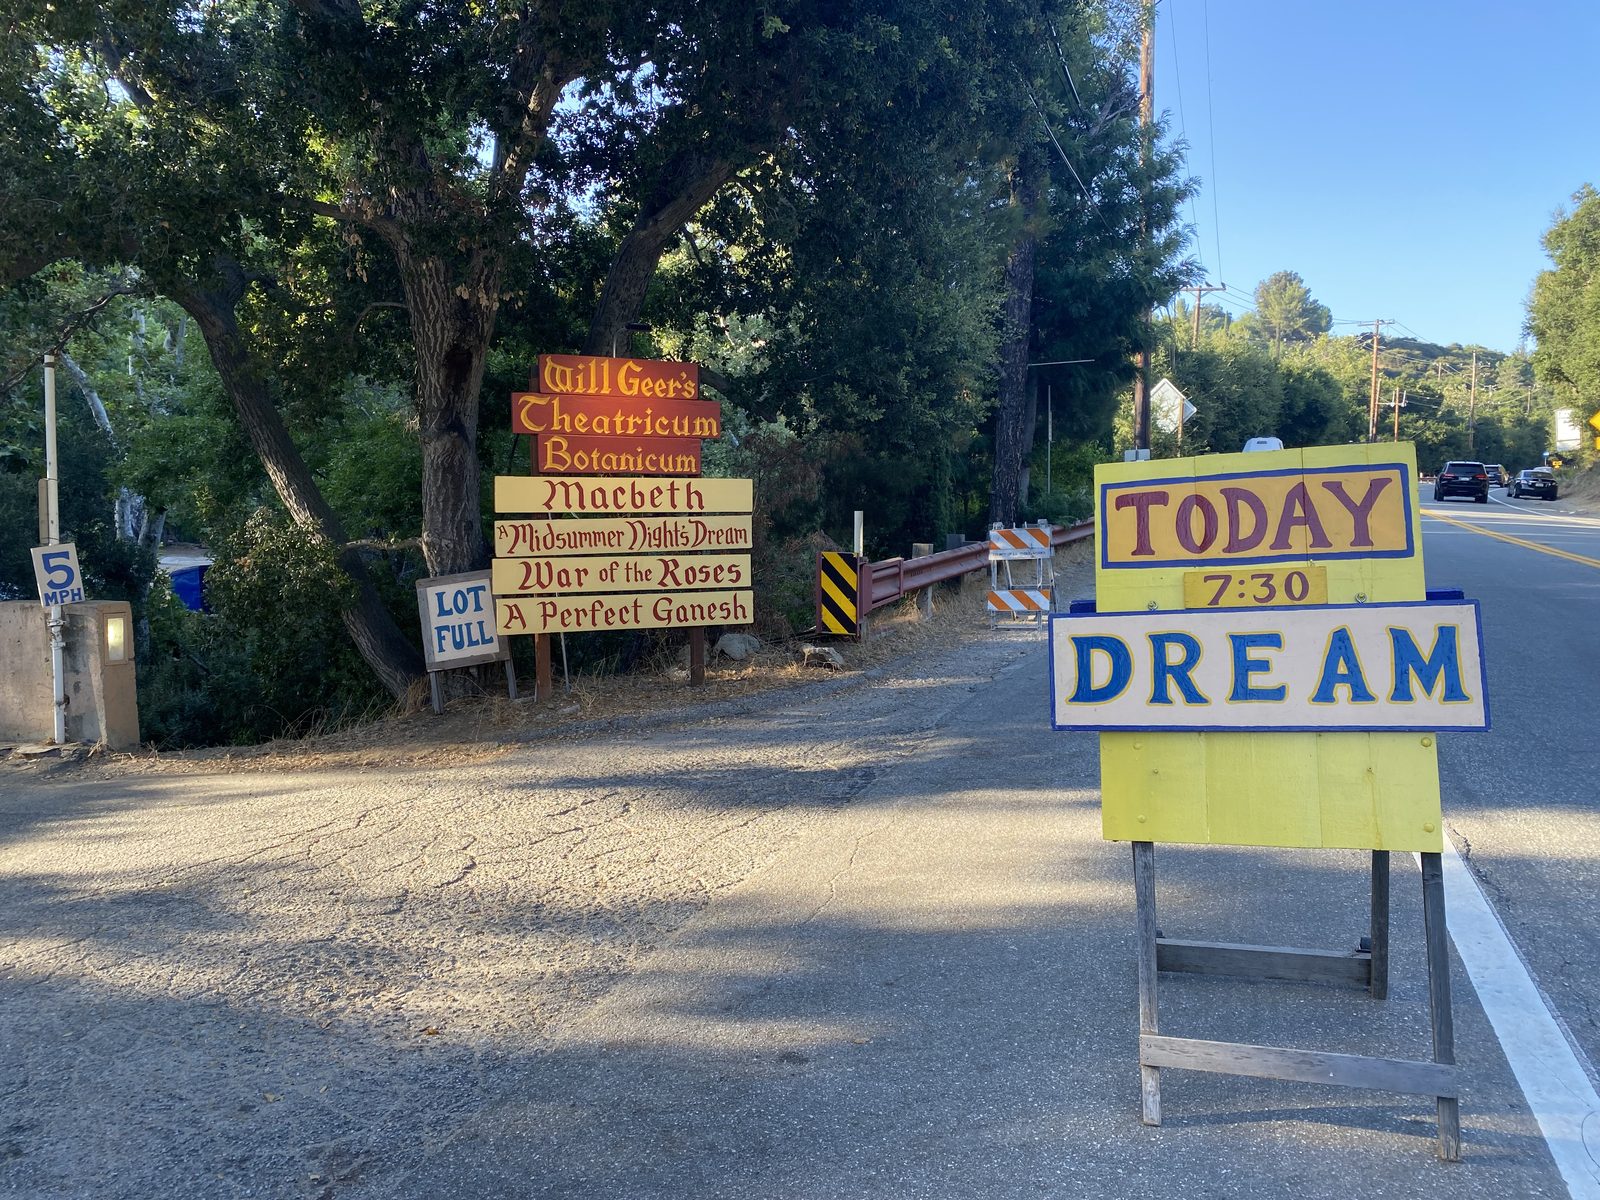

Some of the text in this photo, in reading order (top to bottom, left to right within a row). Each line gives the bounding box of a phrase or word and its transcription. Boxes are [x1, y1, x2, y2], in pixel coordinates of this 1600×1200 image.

[544, 356, 696, 398] Will Geer's
[518, 396, 719, 436] Theatricum
[543, 437, 697, 473] Botanicum
[542, 480, 705, 512] Macbeth
[1115, 478, 1392, 557] TODAY
[498, 519, 748, 554] A Midsummer Night's Dream
[41, 551, 75, 590] 5
[518, 559, 742, 590] War of the Roses
[44, 588, 82, 606] MPH
[435, 585, 486, 617] LOT
[1203, 571, 1310, 606] 7:30
[503, 593, 748, 630] A Perfect Ganesh
[434, 621, 494, 653] FULL
[1066, 624, 1472, 706] DREAM
